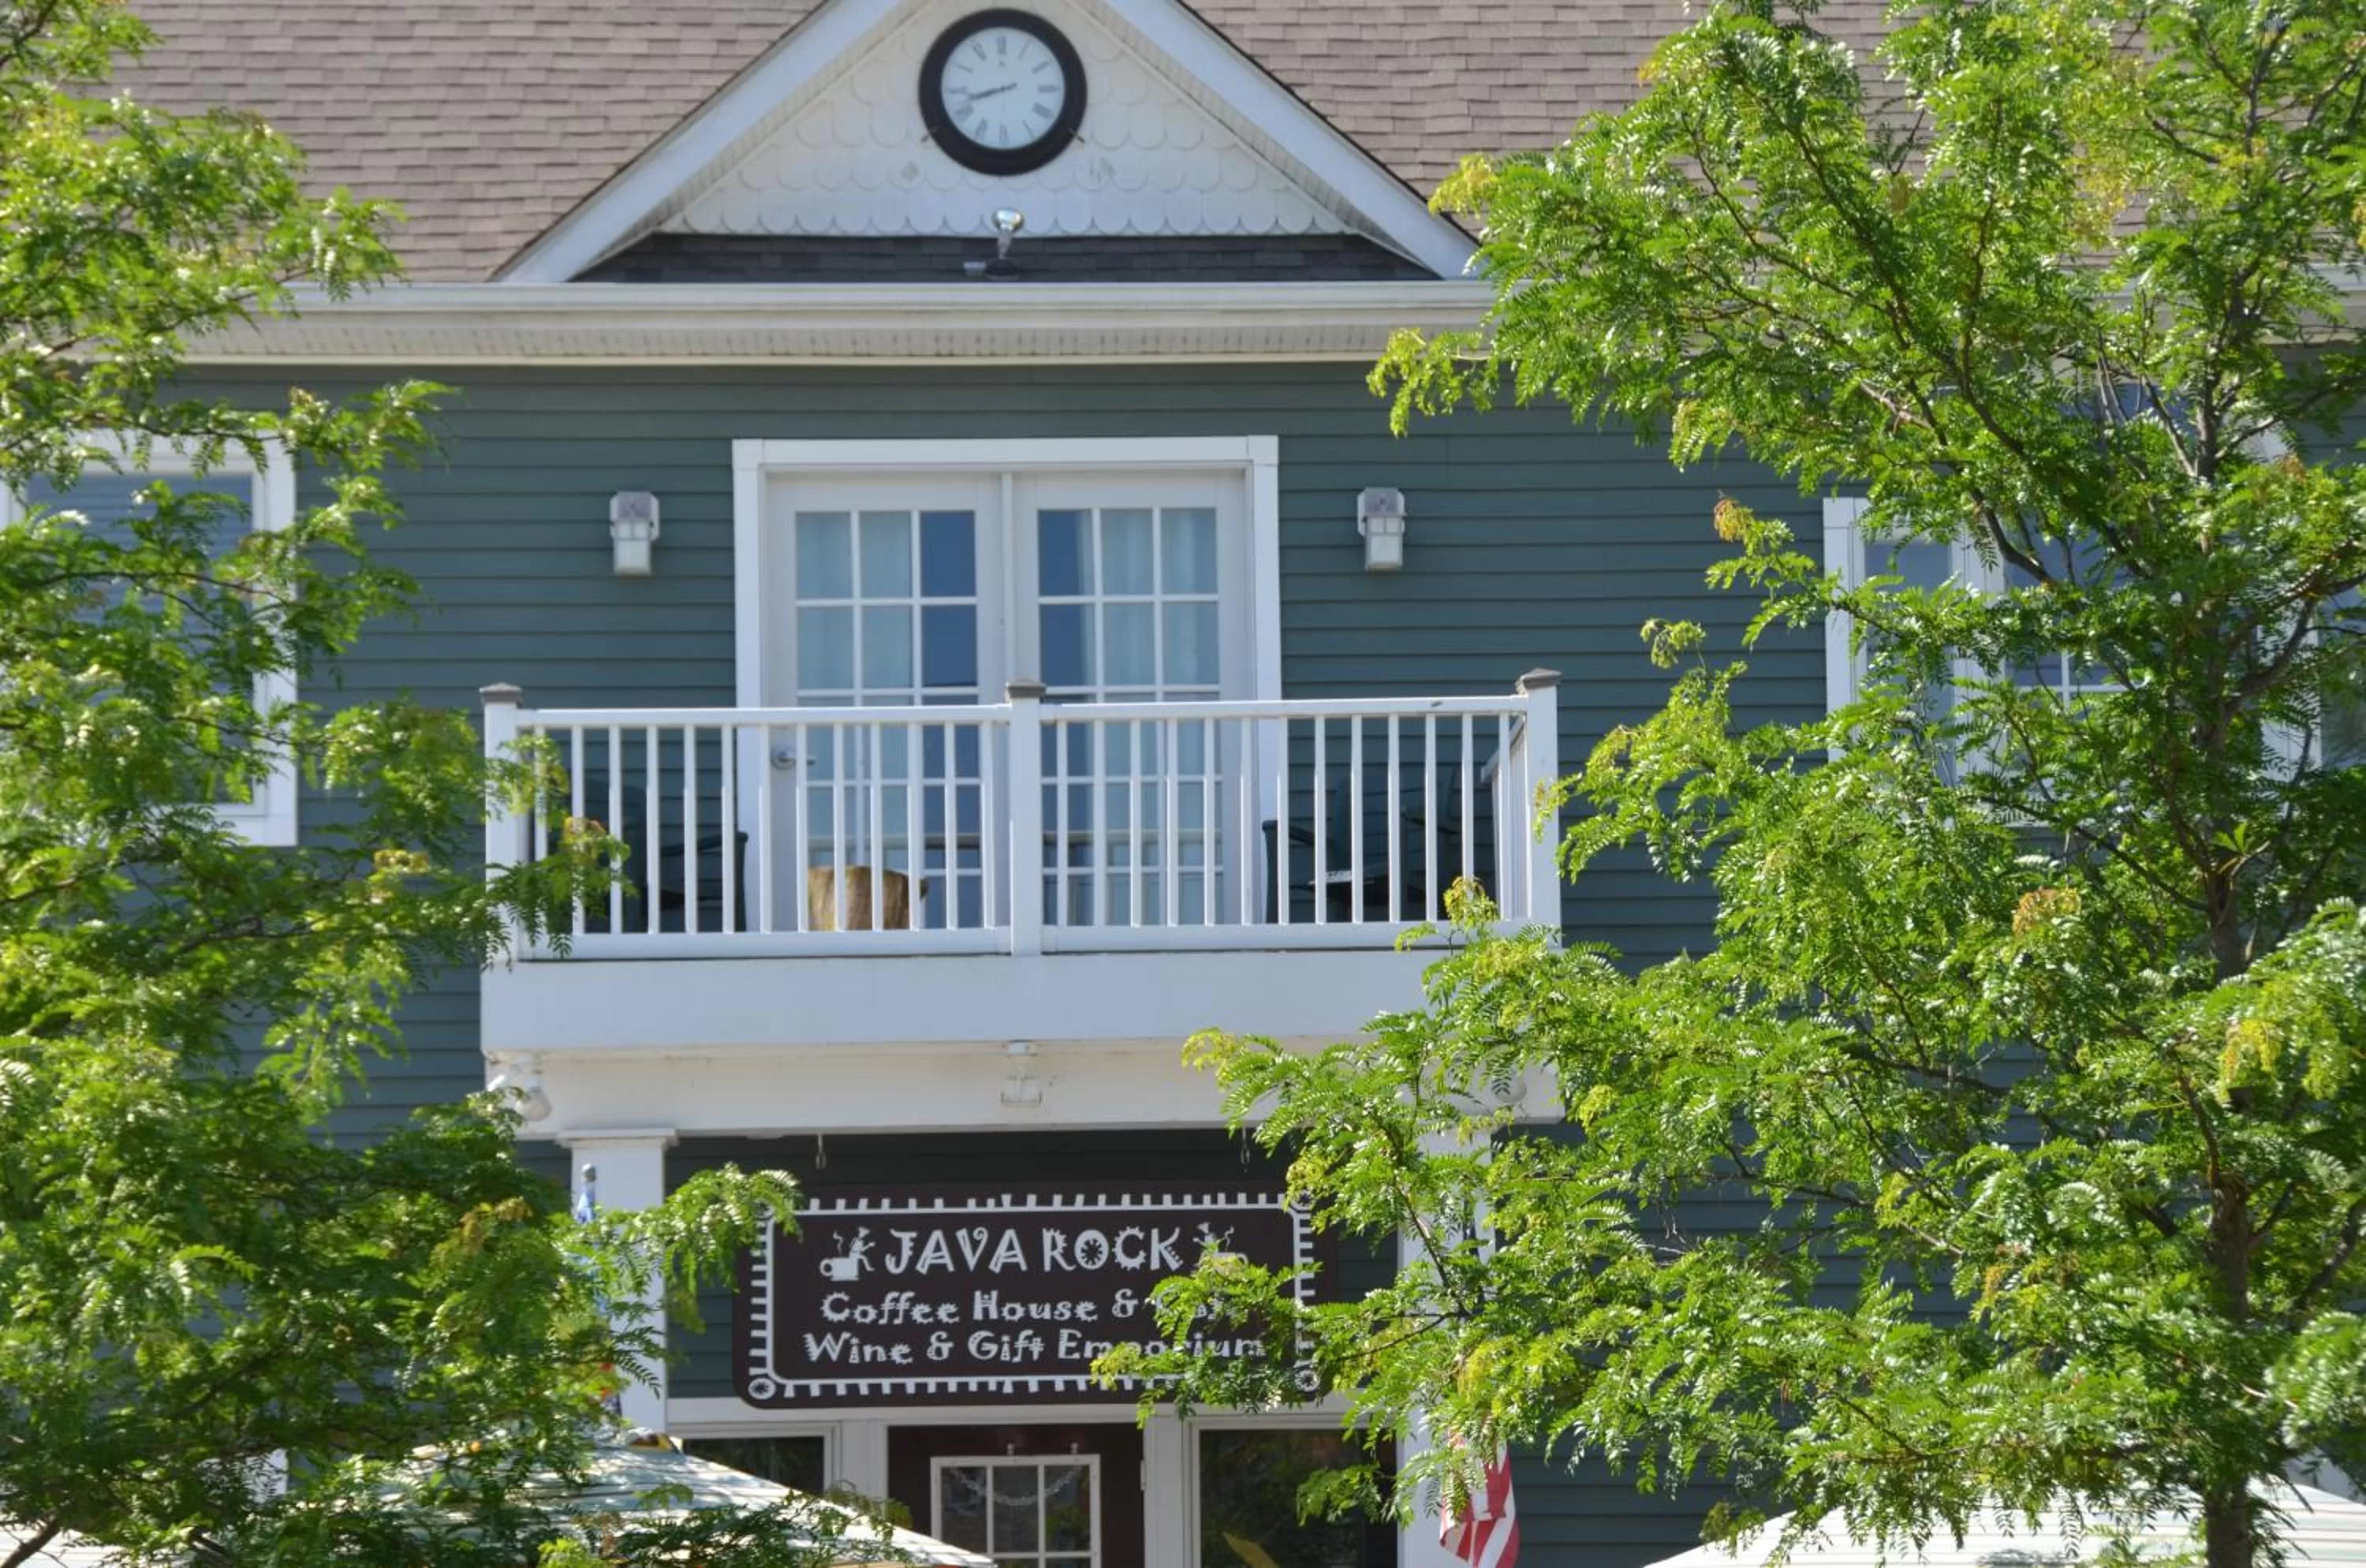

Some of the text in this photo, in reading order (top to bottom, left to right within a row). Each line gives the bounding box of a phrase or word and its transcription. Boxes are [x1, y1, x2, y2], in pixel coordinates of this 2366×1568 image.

[885, 1225, 1184, 1275] JAVA ROCK
[820, 1290, 960, 1325] Coffee
[972, 1290, 1099, 1321] House
[1111, 1288, 1139, 1318] &
[803, 1328, 1267, 1365] Wine & Gift Emoium
